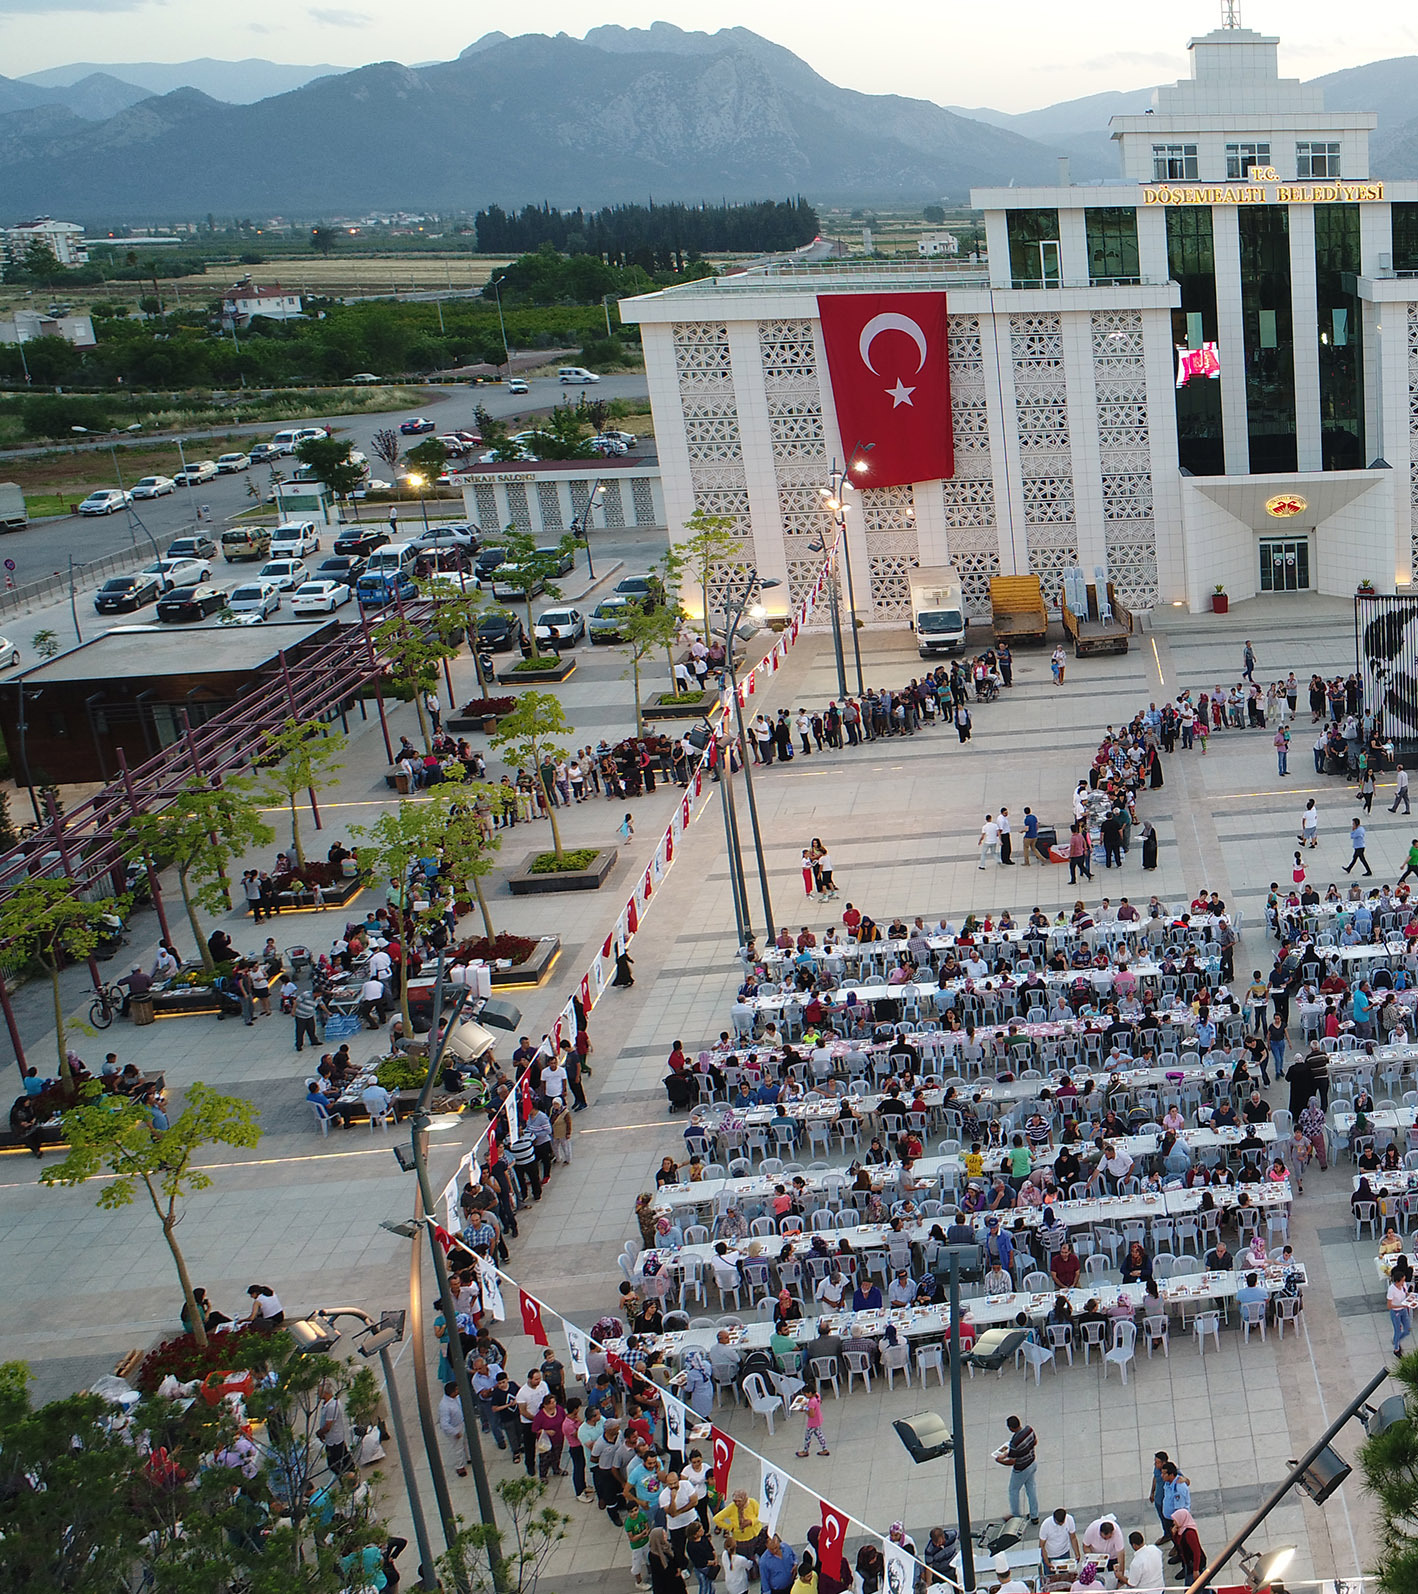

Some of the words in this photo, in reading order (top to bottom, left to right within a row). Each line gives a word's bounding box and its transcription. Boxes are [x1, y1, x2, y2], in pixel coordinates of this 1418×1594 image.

[1251, 167, 1279, 181] T.C.
[1143, 185, 1266, 205] DÖŞEMEALTI
[1277, 181, 1384, 202] BELEDİYESİ
[464, 474, 496, 483] NİKAH
[497, 473, 536, 482] SALONU
